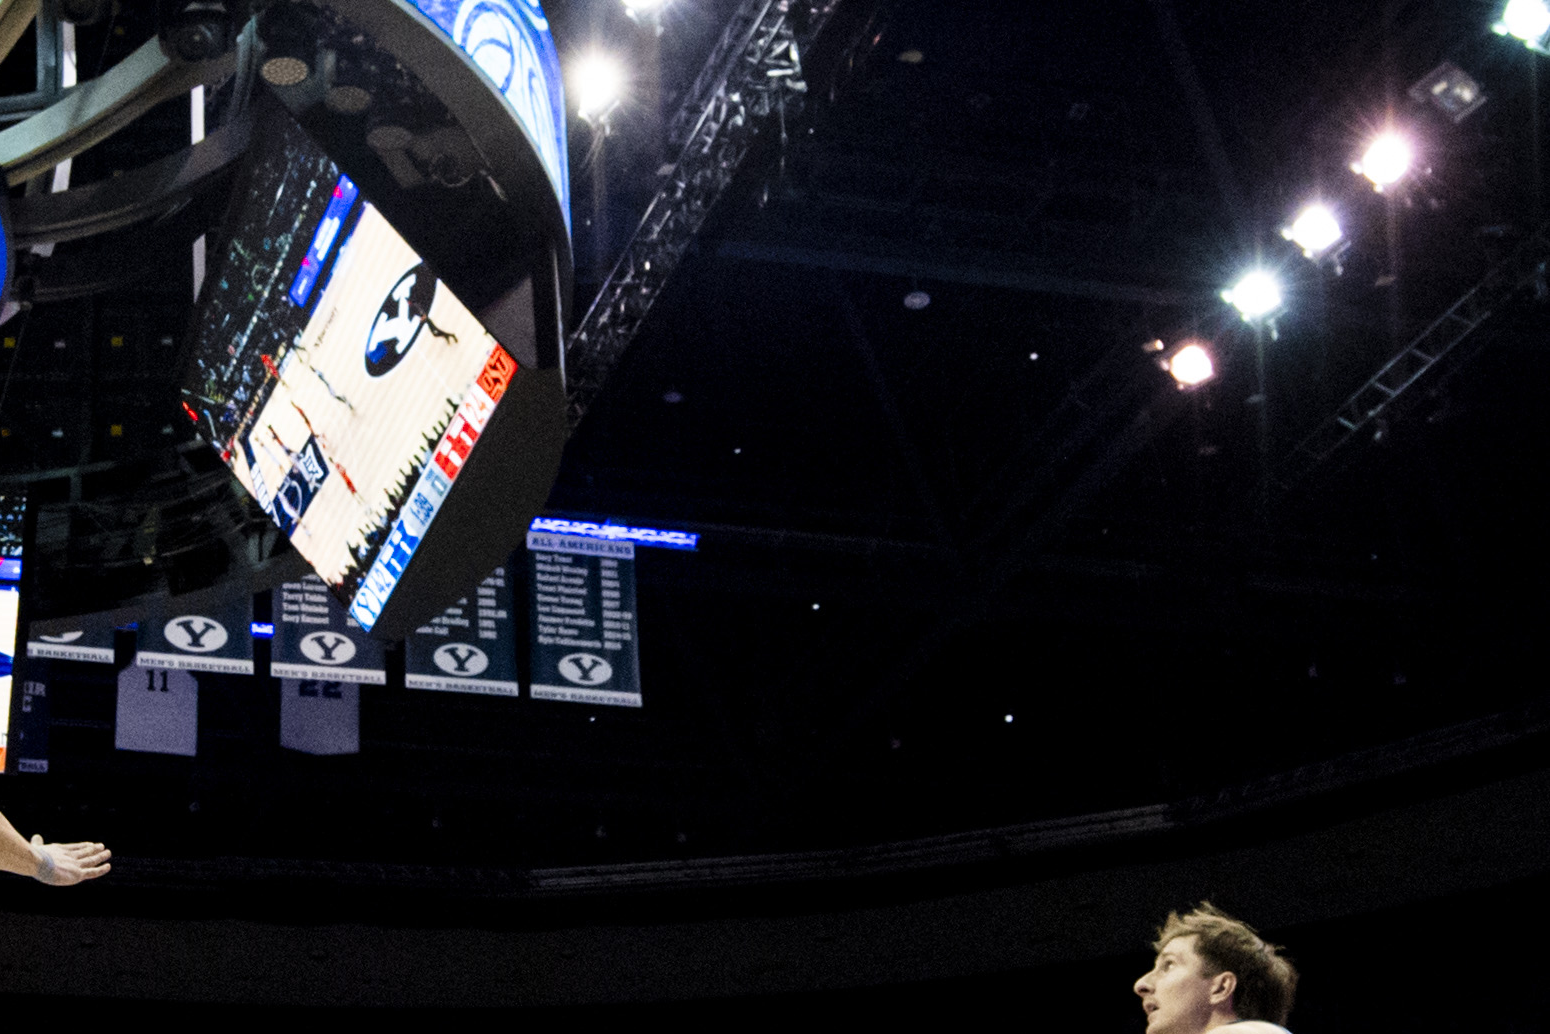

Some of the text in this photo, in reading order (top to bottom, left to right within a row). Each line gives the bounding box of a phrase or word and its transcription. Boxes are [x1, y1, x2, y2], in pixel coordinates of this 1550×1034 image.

[531, 537, 632, 556] ALL AMERICANS
[372, 569, 393, 595] 42
[146, 669, 169, 693] 11
